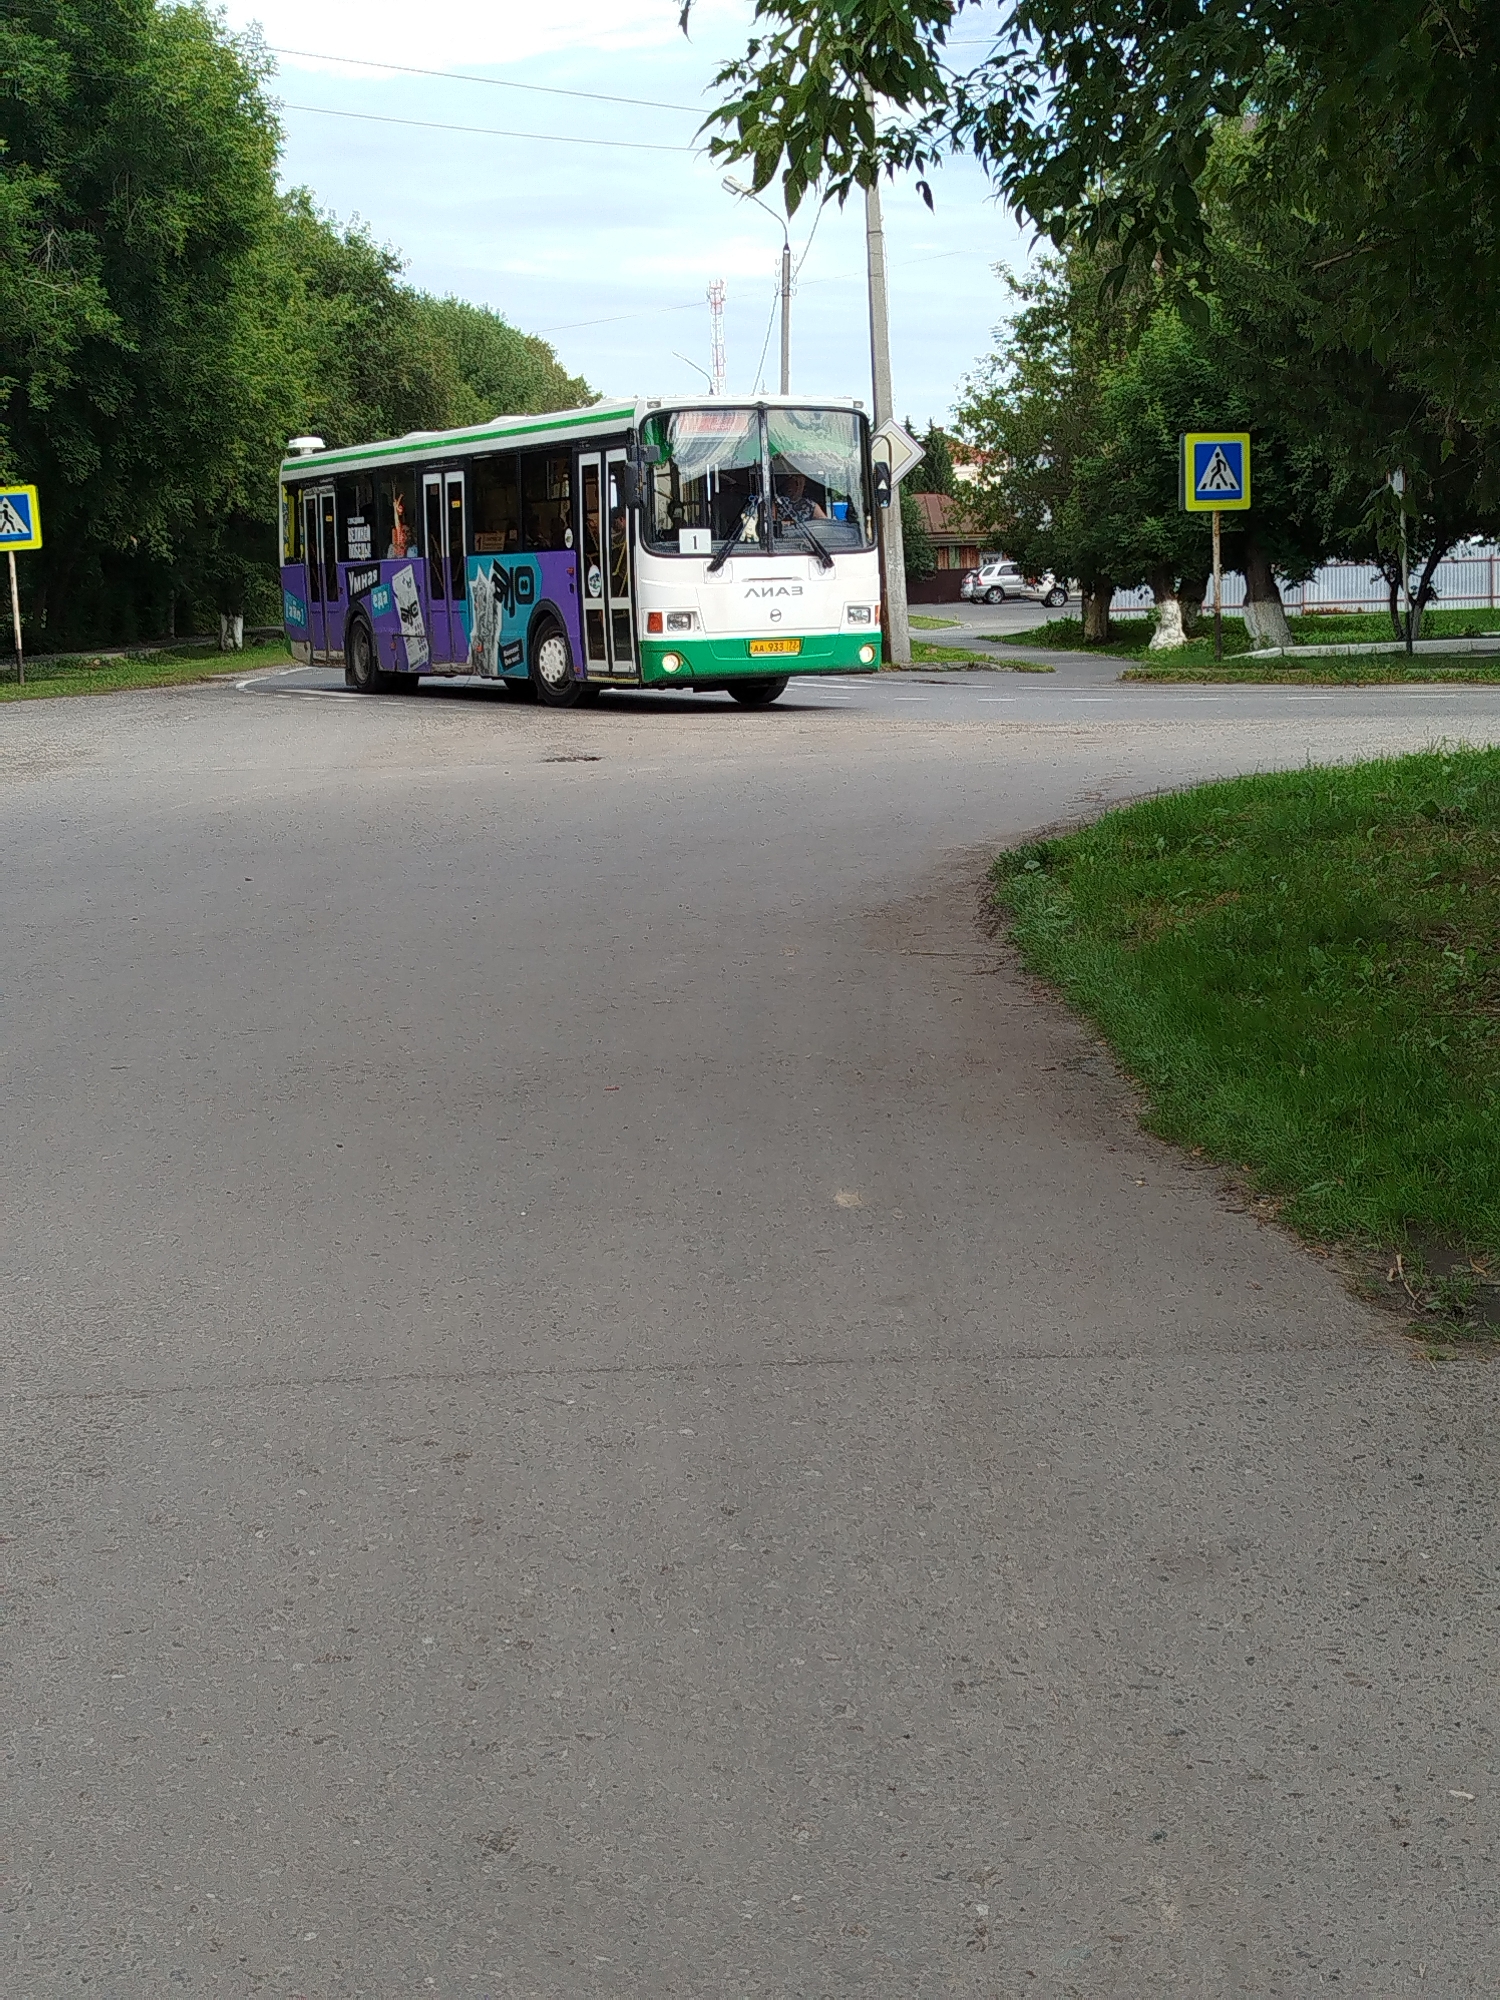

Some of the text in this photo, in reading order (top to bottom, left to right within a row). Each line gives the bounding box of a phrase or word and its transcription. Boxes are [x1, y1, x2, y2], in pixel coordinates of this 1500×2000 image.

[476, 536, 482, 551] 1
[691, 535, 698, 550] 1
[348, 569, 378, 596] Умная
[373, 590, 389, 610] еда
[744, 586, 804, 599] ЛИАЗ
[767, 642, 784, 652] 933
